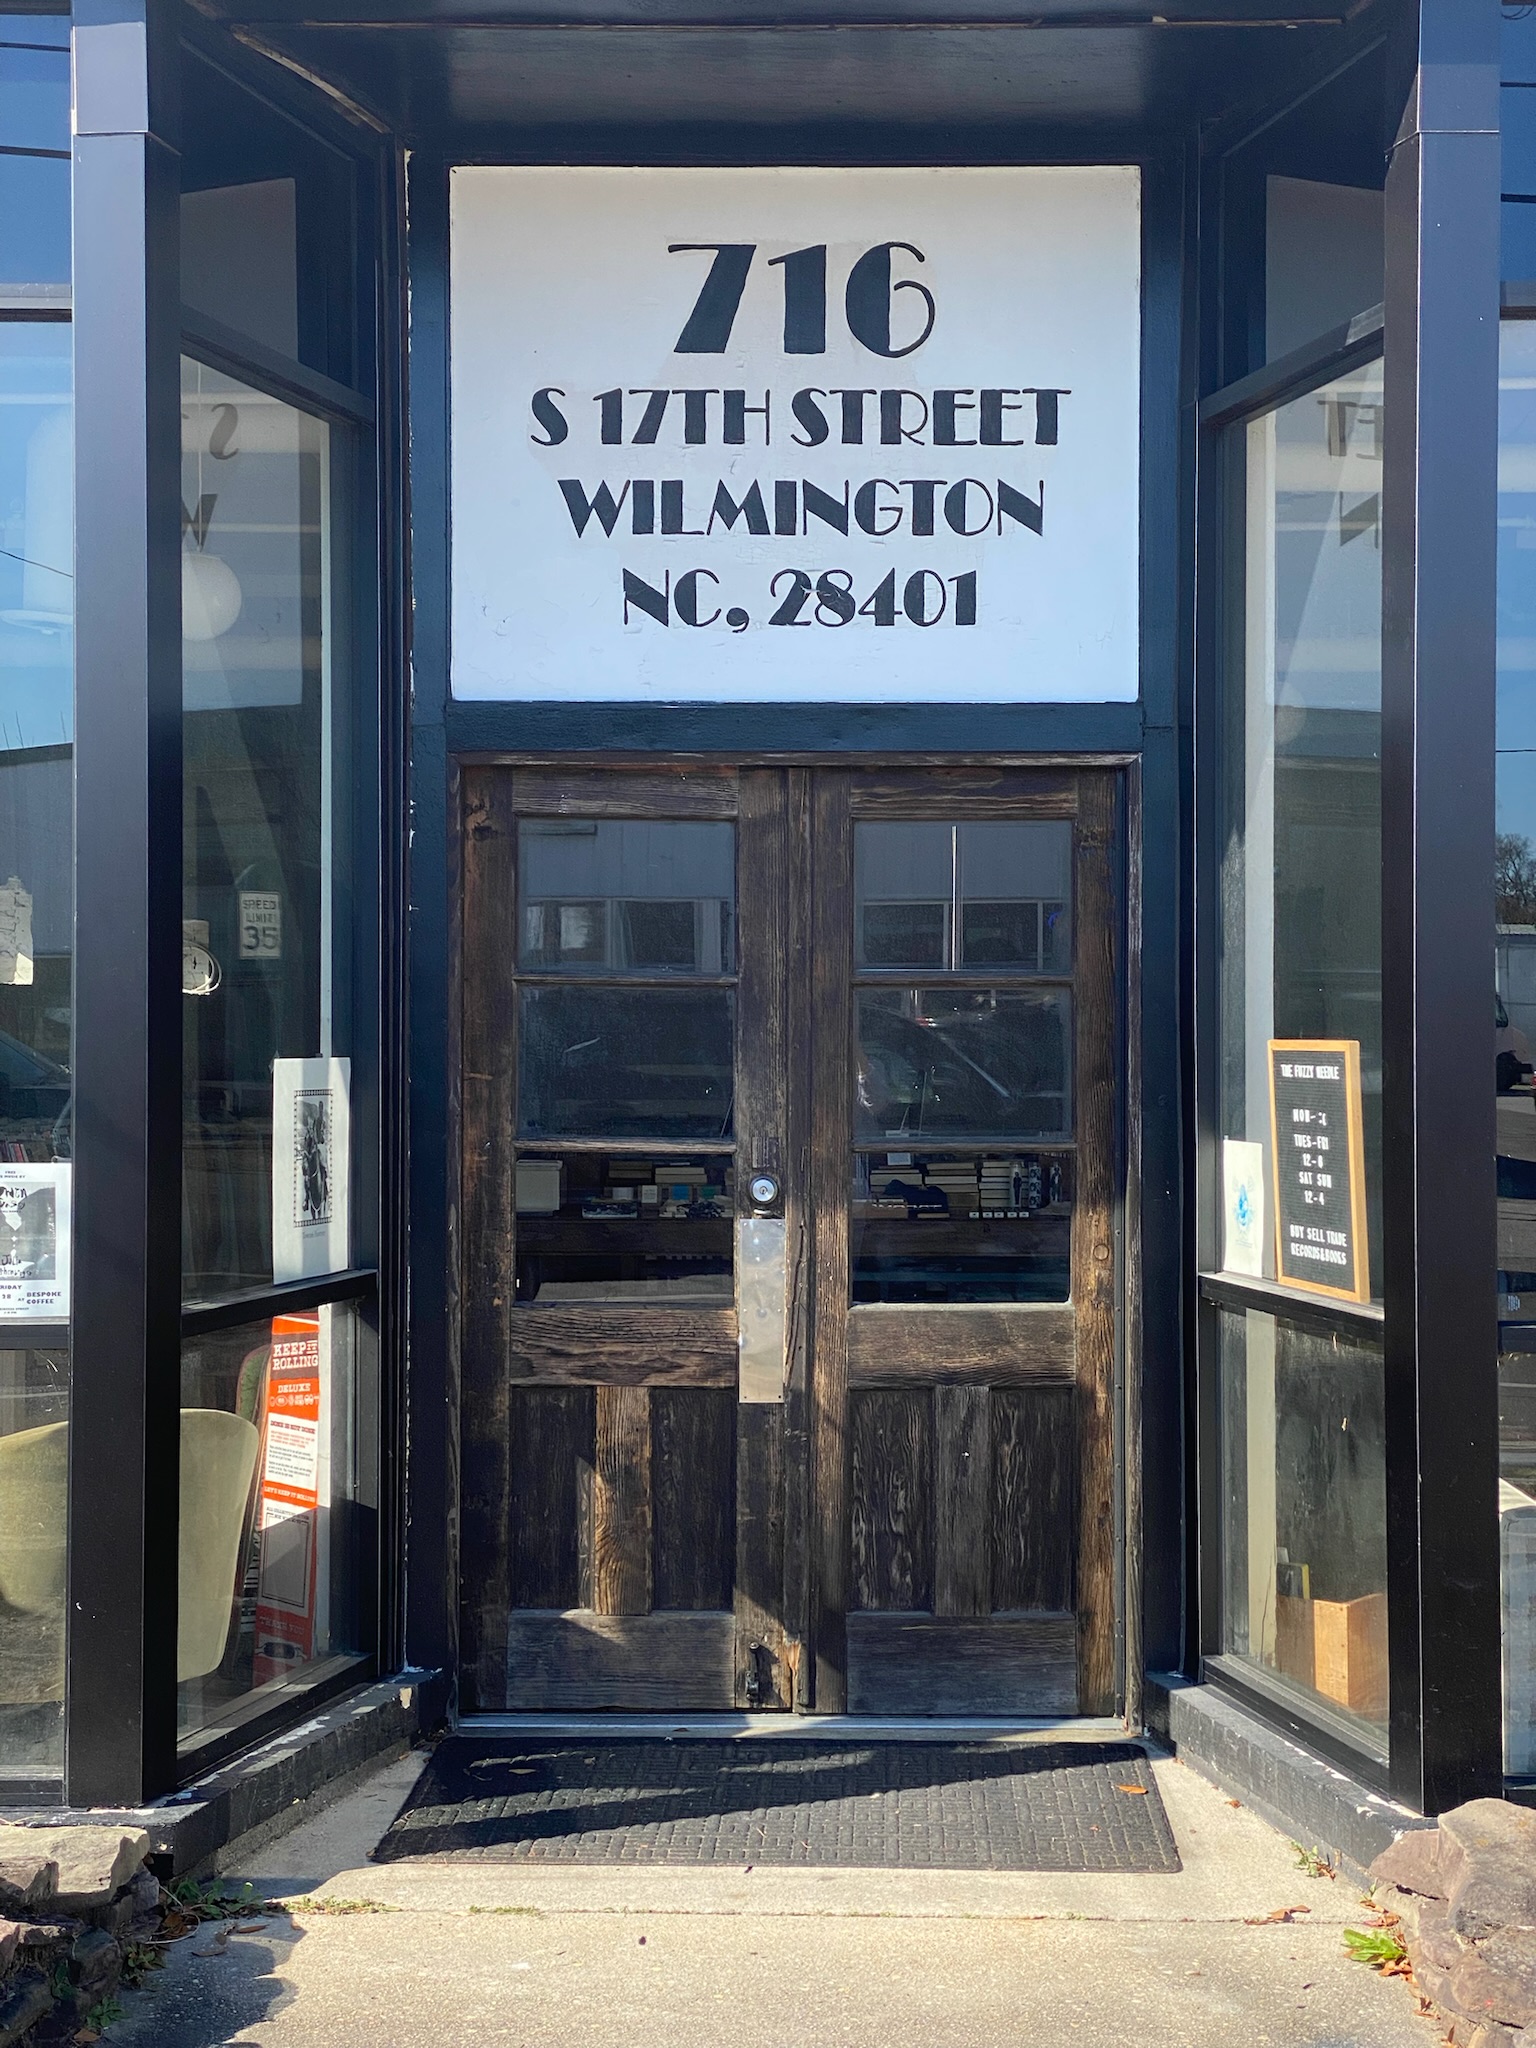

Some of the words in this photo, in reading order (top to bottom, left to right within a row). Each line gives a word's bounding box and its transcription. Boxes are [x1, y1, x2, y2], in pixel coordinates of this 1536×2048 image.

[668, 242, 936, 358] 716
[531, 388, 569, 447] S
[593, 388, 771, 446] 17TH
[791, 388, 1072, 448] STREET
[557, 479, 1044, 539] WILMINGTON
[622, 568, 750, 634] NC,
[769, 568, 977, 628] 28401
[243, 899, 277, 910] SPEED
[246, 912, 274, 923] LIMIT
[243, 925, 278, 950] 35
[1280, 1064, 1293, 1077] THE
[1294, 1065, 1314, 1079] FUZZY
[1298, 1171, 1313, 1185] SAT
[1317, 1174, 1332, 1189] SUN
[1290, 1224, 1304, 1239] BUY
[1307, 1227, 1325, 1243] SELL
[1326, 1230, 1347, 1247] TRADE
[272, 1341, 307, 1357] KEEP
[307, 1343, 318, 1351] IT
[272, 1354, 319, 1371] ROLLING
[277, 1383, 311, 1394] DELUXE
[278, 1489, 290, 1497] KEEP
